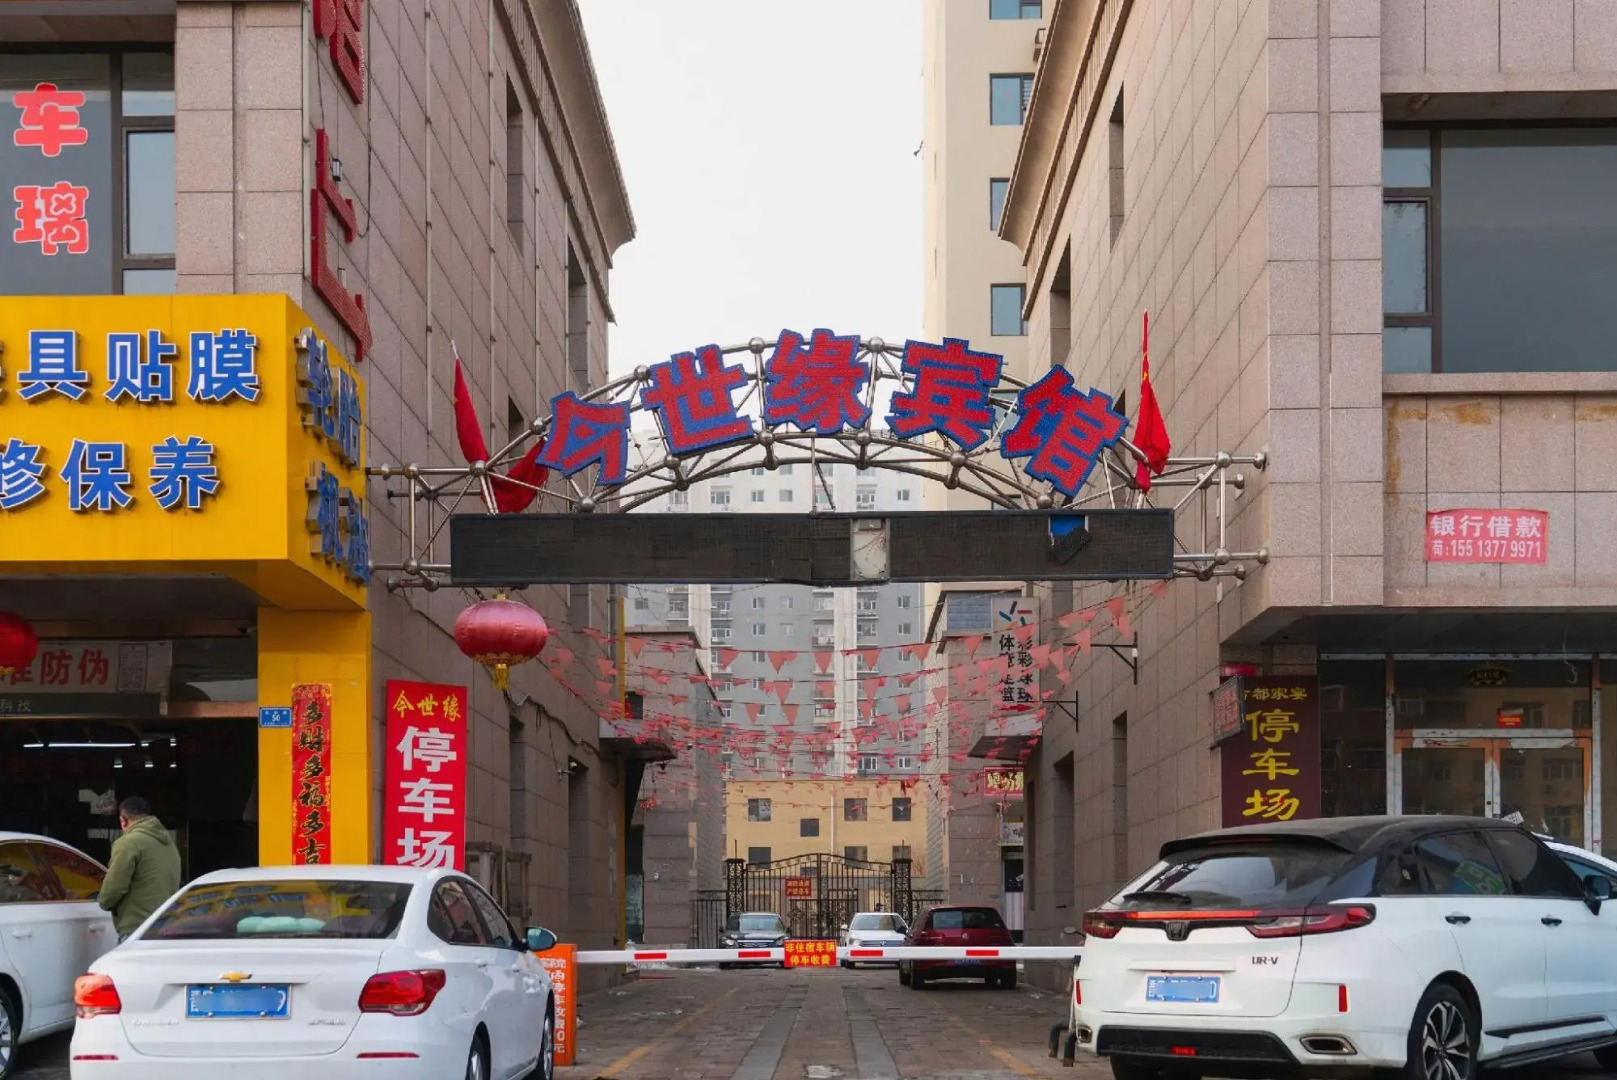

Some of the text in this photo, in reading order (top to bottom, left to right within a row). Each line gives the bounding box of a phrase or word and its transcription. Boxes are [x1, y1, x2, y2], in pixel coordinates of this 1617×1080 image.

[14, 83, 88, 157] 车
[14, 181, 89, 255] 璃
[0, 328, 259, 401] 具贴膜
[535, 328, 1130, 498] 今世缘宾馆
[0, 435, 220, 511] 修保养
[1430, 515, 1541, 538] 银行借款
[393, 690, 461, 722] 今世缘
[396, 726, 457, 871] 停车场
[1242, 708, 1300, 821] 停车场
[785, 942, 835, 953] 非住宿车辆
[790, 954, 830, 965] 停车收费
[1252, 956, 1278, 965] UR-V
